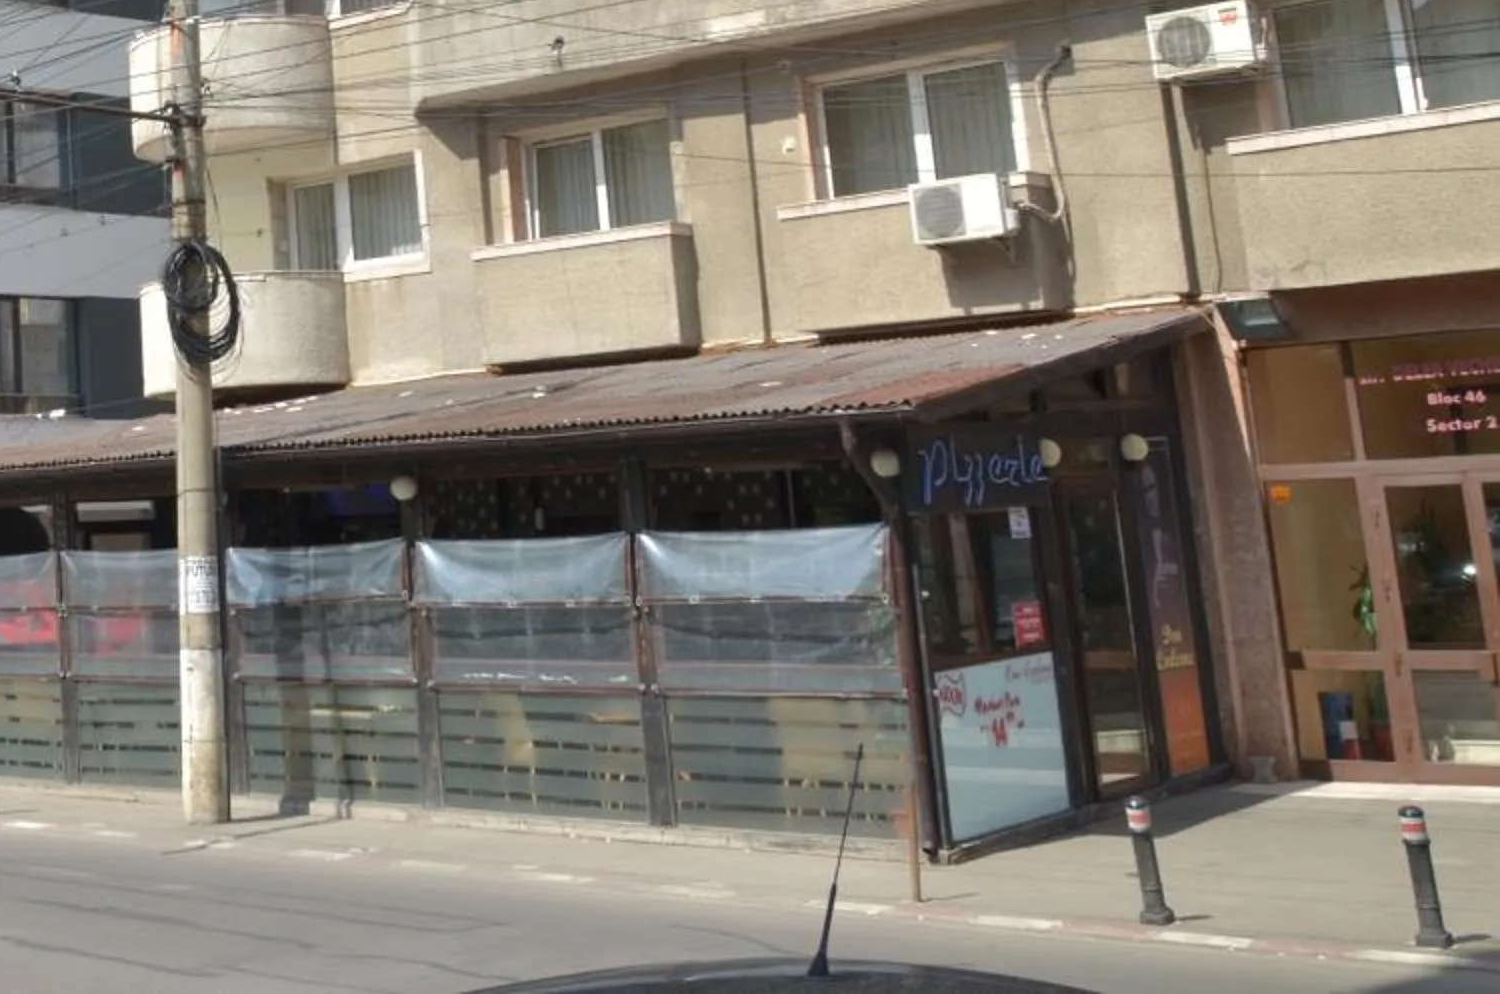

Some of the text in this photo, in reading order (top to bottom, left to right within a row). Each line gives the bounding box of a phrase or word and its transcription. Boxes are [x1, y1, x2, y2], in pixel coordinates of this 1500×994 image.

[1427, 390, 1487, 405] Bloc 46
[1426, 418, 1481, 433] Sector
